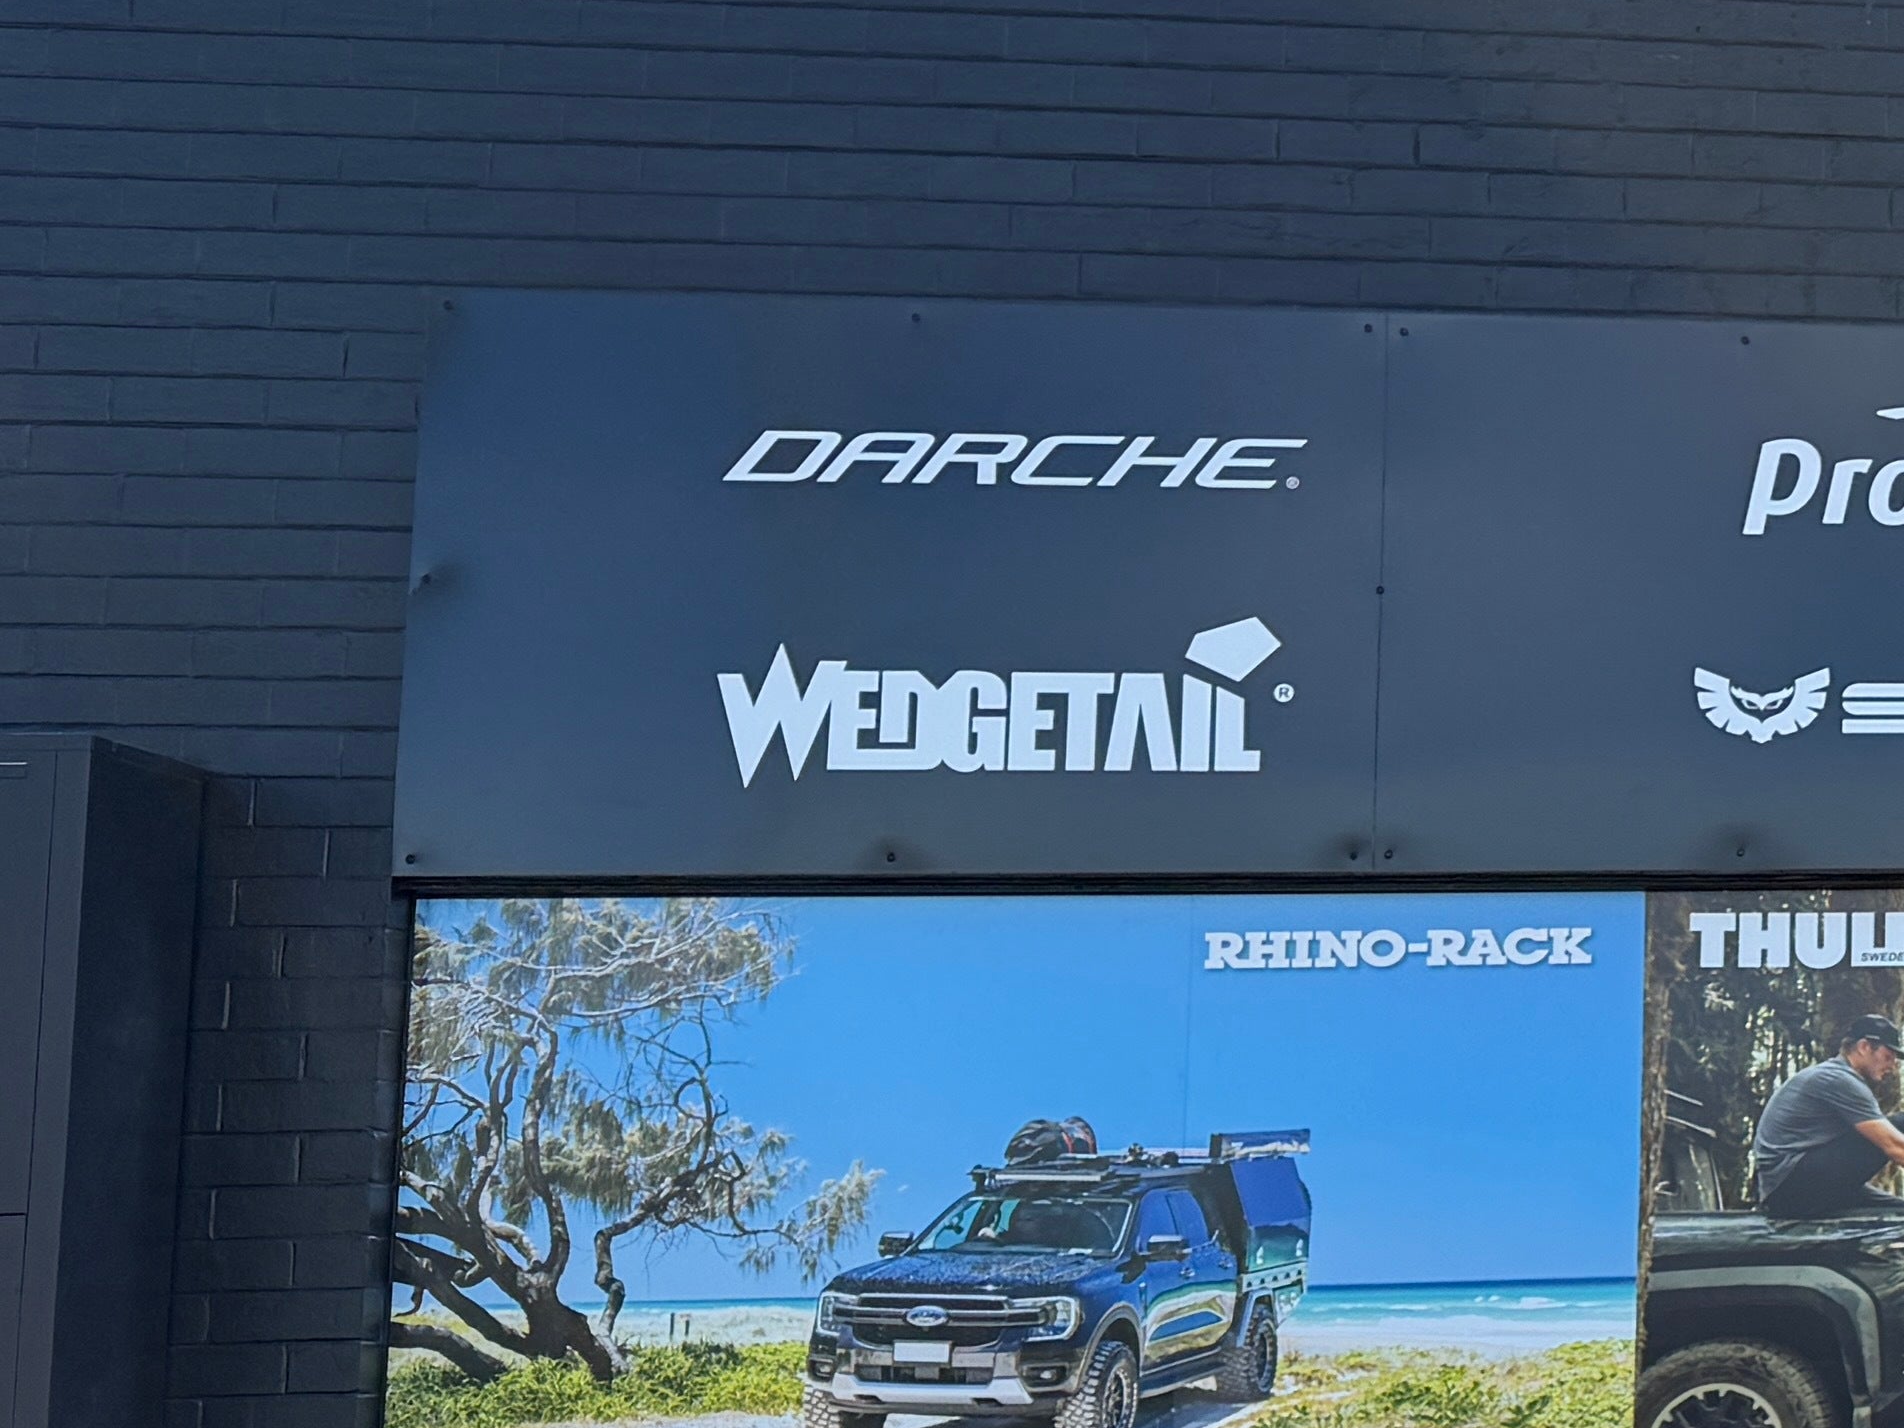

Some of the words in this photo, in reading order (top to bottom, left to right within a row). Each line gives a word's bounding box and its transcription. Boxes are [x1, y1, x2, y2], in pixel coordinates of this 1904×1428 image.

[722, 430, 1308, 489] DARCHE
[716, 642, 1261, 789] WEDGETAIL
[1204, 927, 1592, 969] RHINO-RACK
